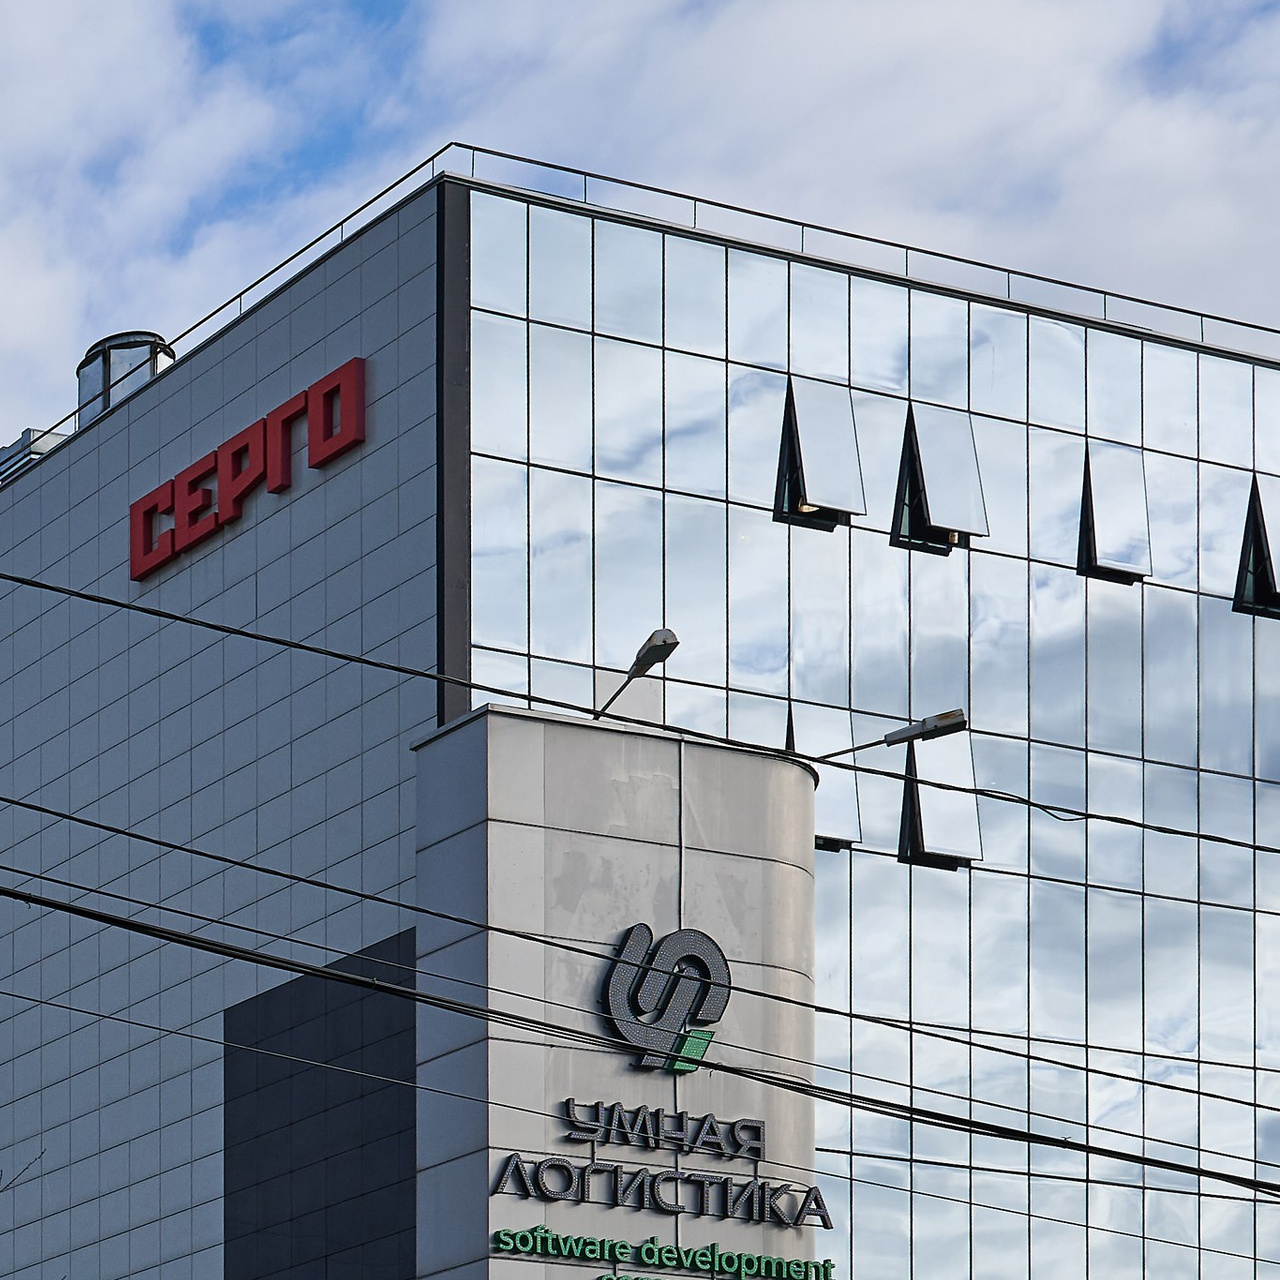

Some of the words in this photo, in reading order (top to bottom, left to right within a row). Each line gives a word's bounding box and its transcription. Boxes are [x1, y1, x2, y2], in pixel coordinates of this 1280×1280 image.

[130, 357, 365, 581] СЕРГО
[565, 1097, 766, 1161] УМНАЯ
[493, 1153, 834, 1230] ЛОГИСТИКА
[495, 1225, 632, 1263] software
